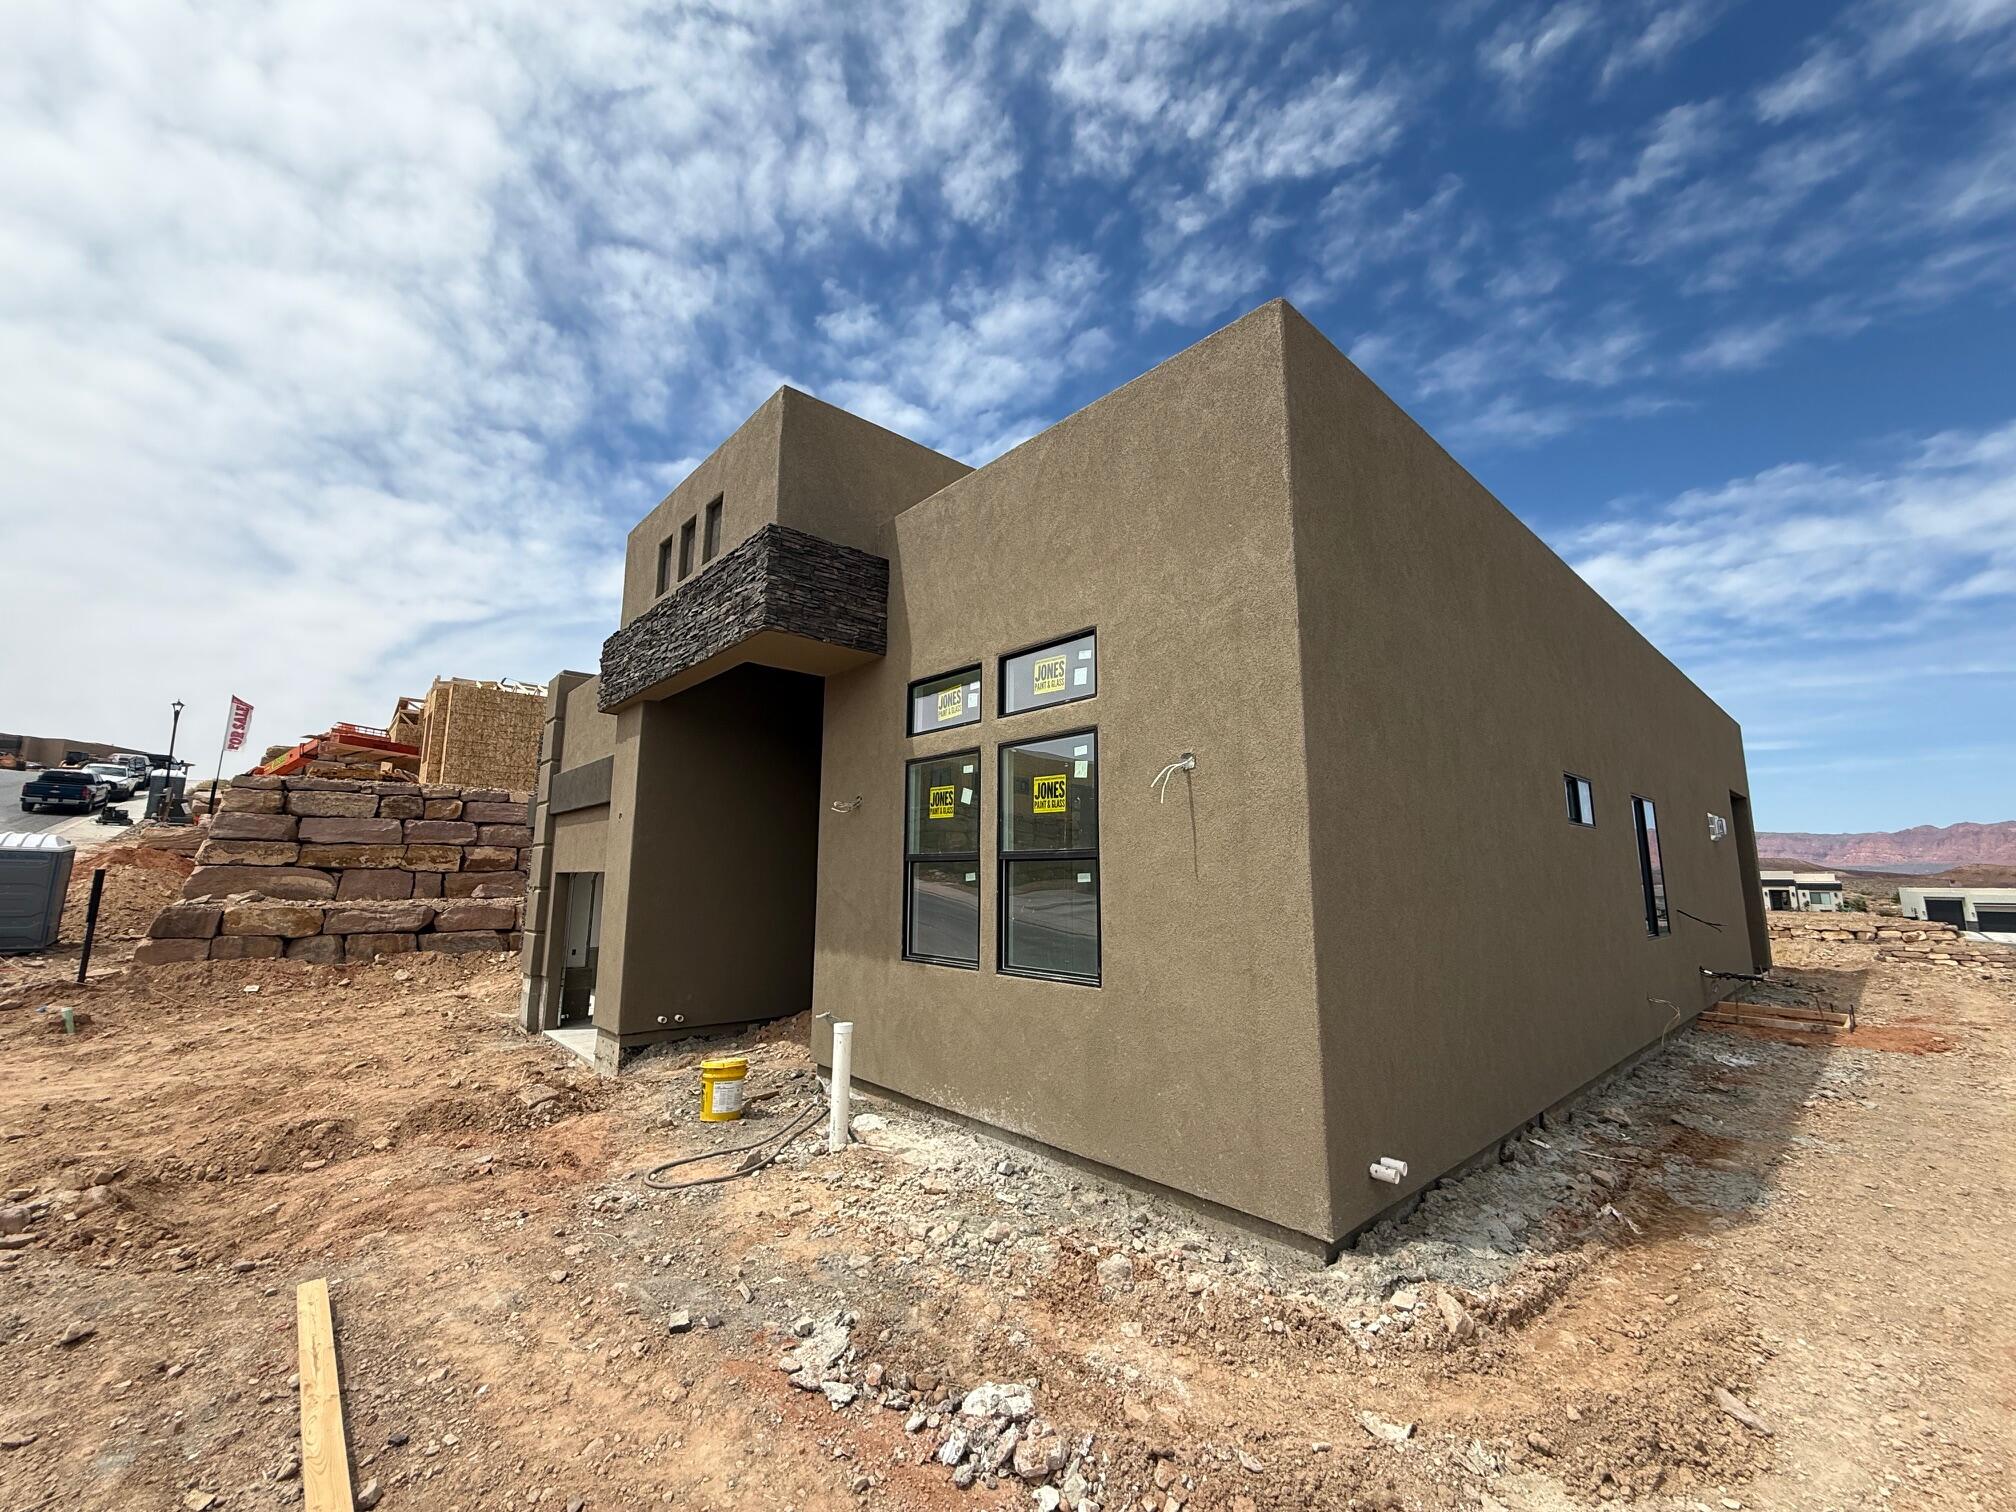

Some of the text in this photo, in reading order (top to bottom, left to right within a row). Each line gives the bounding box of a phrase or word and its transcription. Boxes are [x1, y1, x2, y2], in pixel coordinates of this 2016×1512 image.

[1034, 660, 1065, 682] JONES
[1034, 681, 1047, 691] PAINT
[1051, 678, 1065, 688] GLASS
[939, 689, 961, 711] JONES
[227, 704, 250, 750] FOR SALE
[930, 790, 953, 807] JONES
[1034, 780, 1065, 800] JONES
[930, 807, 939, 815] PAINT
[943, 806, 954, 814] GLASS
[1034, 800, 1047, 809] PAINT
[1051, 799, 1065, 808] GLASS
